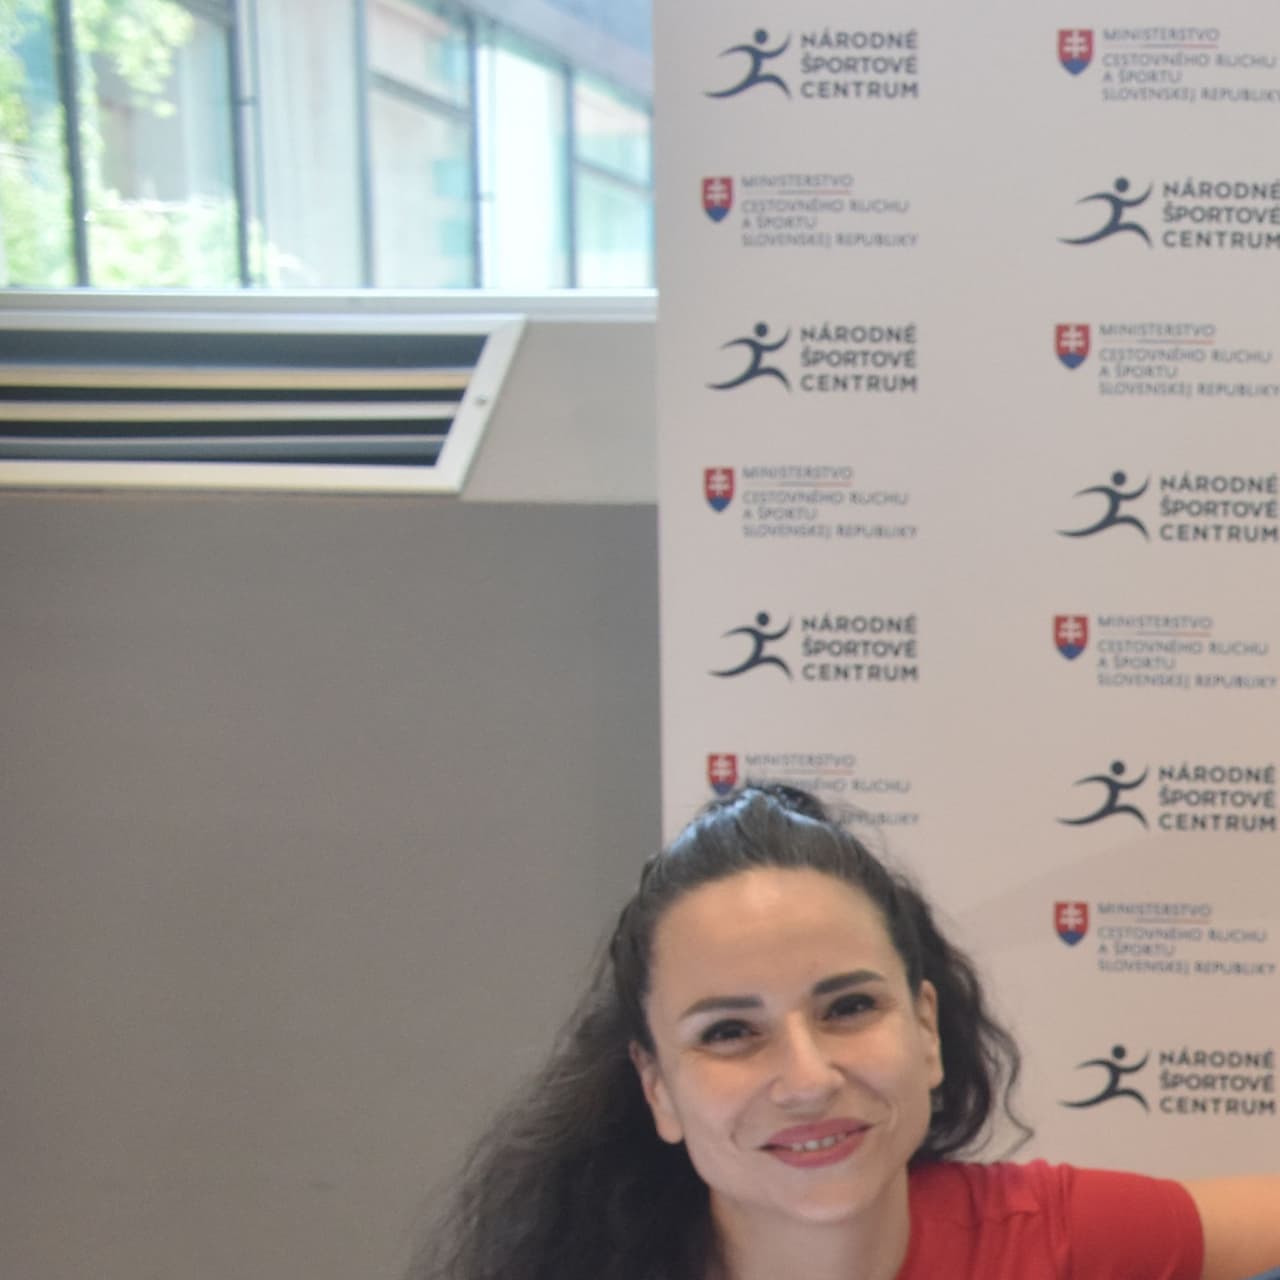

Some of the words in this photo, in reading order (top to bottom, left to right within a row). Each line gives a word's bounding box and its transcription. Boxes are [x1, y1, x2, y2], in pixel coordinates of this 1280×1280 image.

[800, 27, 917, 49] NÁRODNÉ
[800, 52, 917, 74] ŠPORTOVÉ
[800, 81, 918, 98] CENTRUM
[800, 321, 916, 343] NÁRODNÉ
[800, 345, 916, 368] ŠPORTOVÉ
[799, 375, 917, 392] CENTRUM
[1159, 471, 1278, 494] NÁRODNÉ
[1159, 495, 1277, 519] ŠPORTOVÉ
[1159, 524, 1278, 543] CENTRUM
[801, 612, 916, 634] NÁRODNÉ
[801, 635, 916, 658] ŠPORTOVÉ
[801, 664, 917, 682] CENTRUM
[1158, 761, 1275, 784] NÁRODNÉ
[1158, 784, 1275, 808] ŠPORTOVÉ
[1158, 813, 1276, 832] CENTRUM
[1159, 1046, 1274, 1069] NÁRODNÉ
[1159, 1069, 1274, 1092] ŠPORTOVÉ
[1159, 1097, 1275, 1115] CENTRUM
